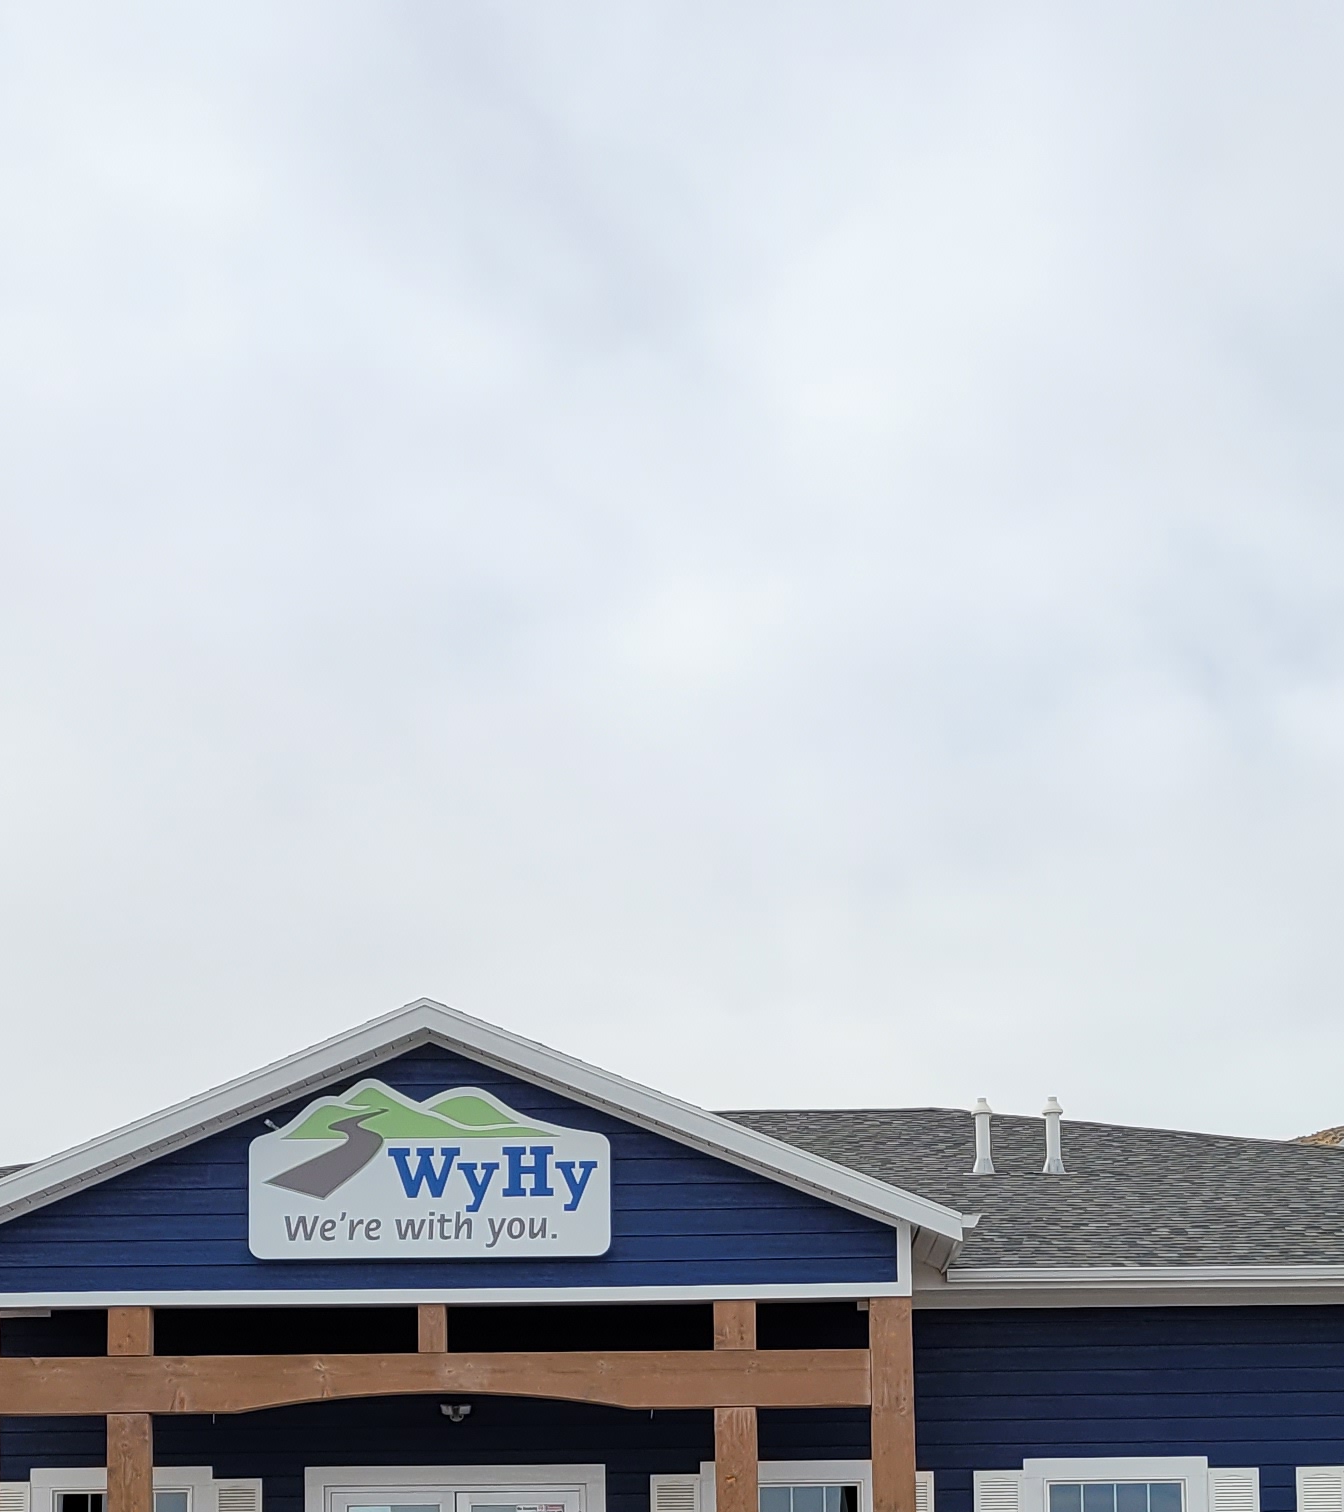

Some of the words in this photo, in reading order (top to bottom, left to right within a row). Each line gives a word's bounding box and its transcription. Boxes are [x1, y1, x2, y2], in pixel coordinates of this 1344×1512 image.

[387, 1145, 598, 1213] WyHy
[284, 1212, 382, 1242] We're
[395, 1211, 474, 1241] with
[485, 1215, 559, 1249] you.
